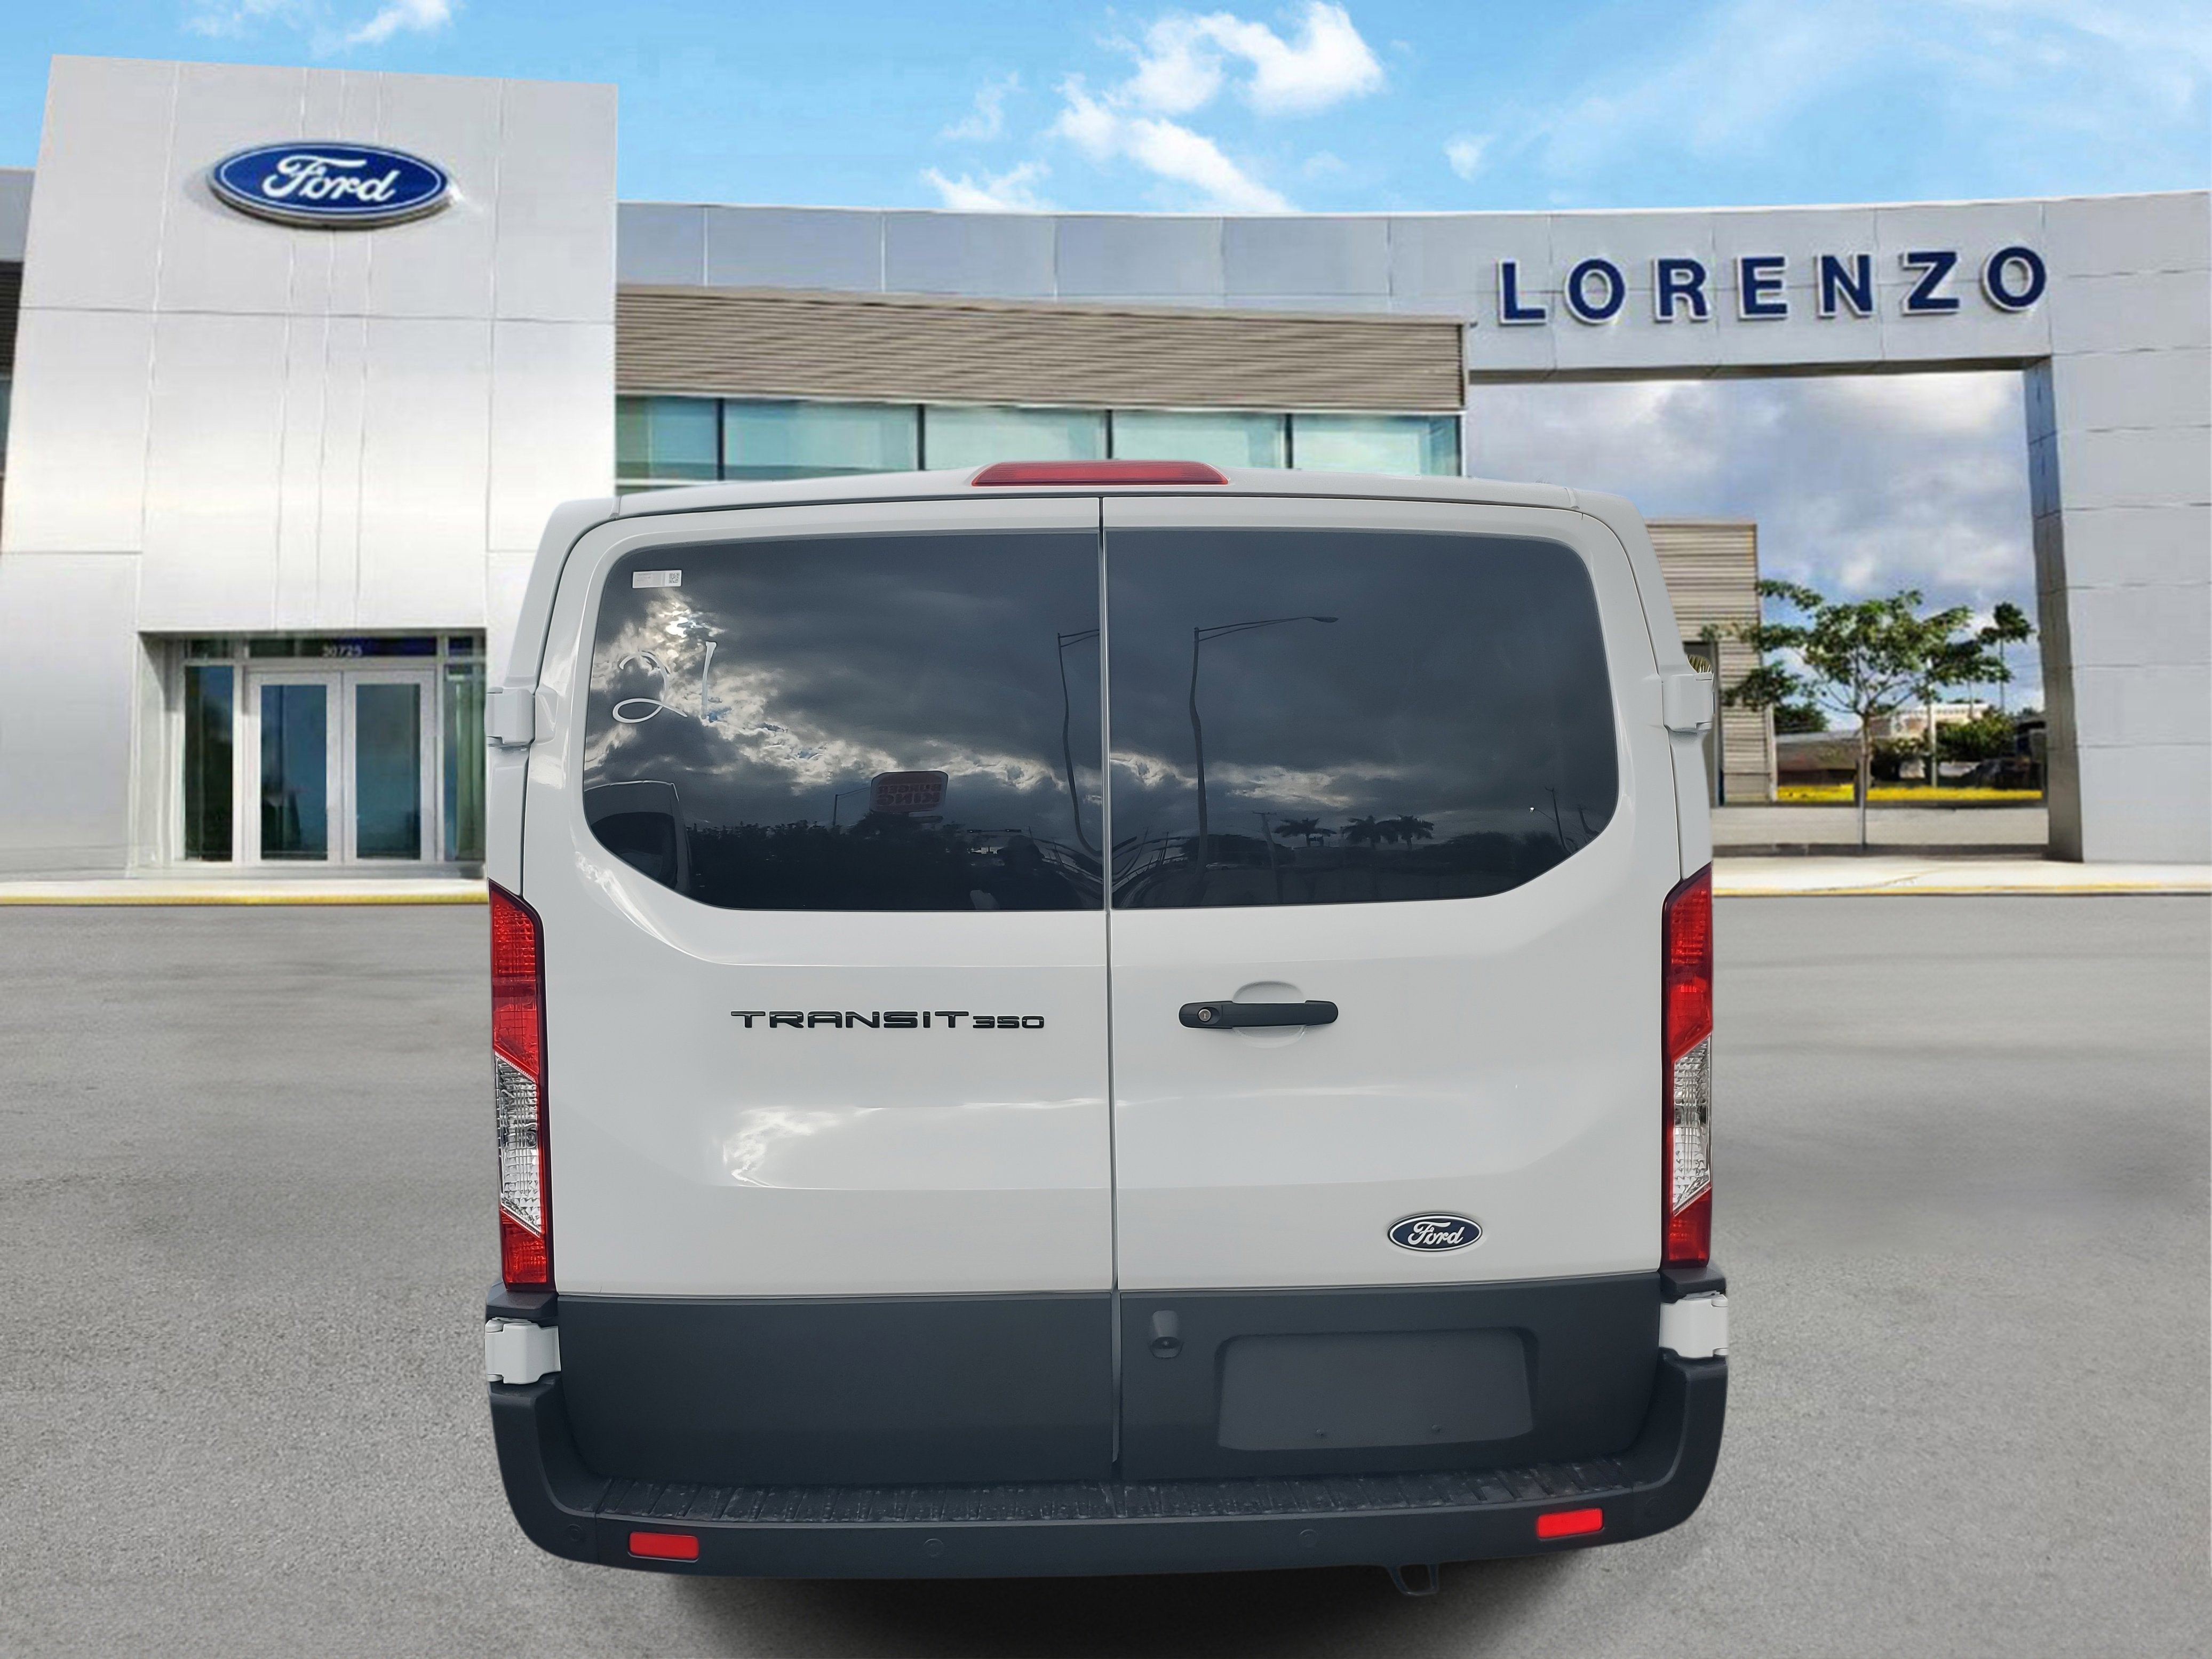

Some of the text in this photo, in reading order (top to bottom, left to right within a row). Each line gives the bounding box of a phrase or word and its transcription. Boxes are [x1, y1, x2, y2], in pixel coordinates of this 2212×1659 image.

[262, 155, 400, 201] Ford
[1497, 246, 2047, 323] LORENZO
[730, 1011, 1045, 1029] TRANSIT 350
[1407, 1221, 1465, 1245] Ford
